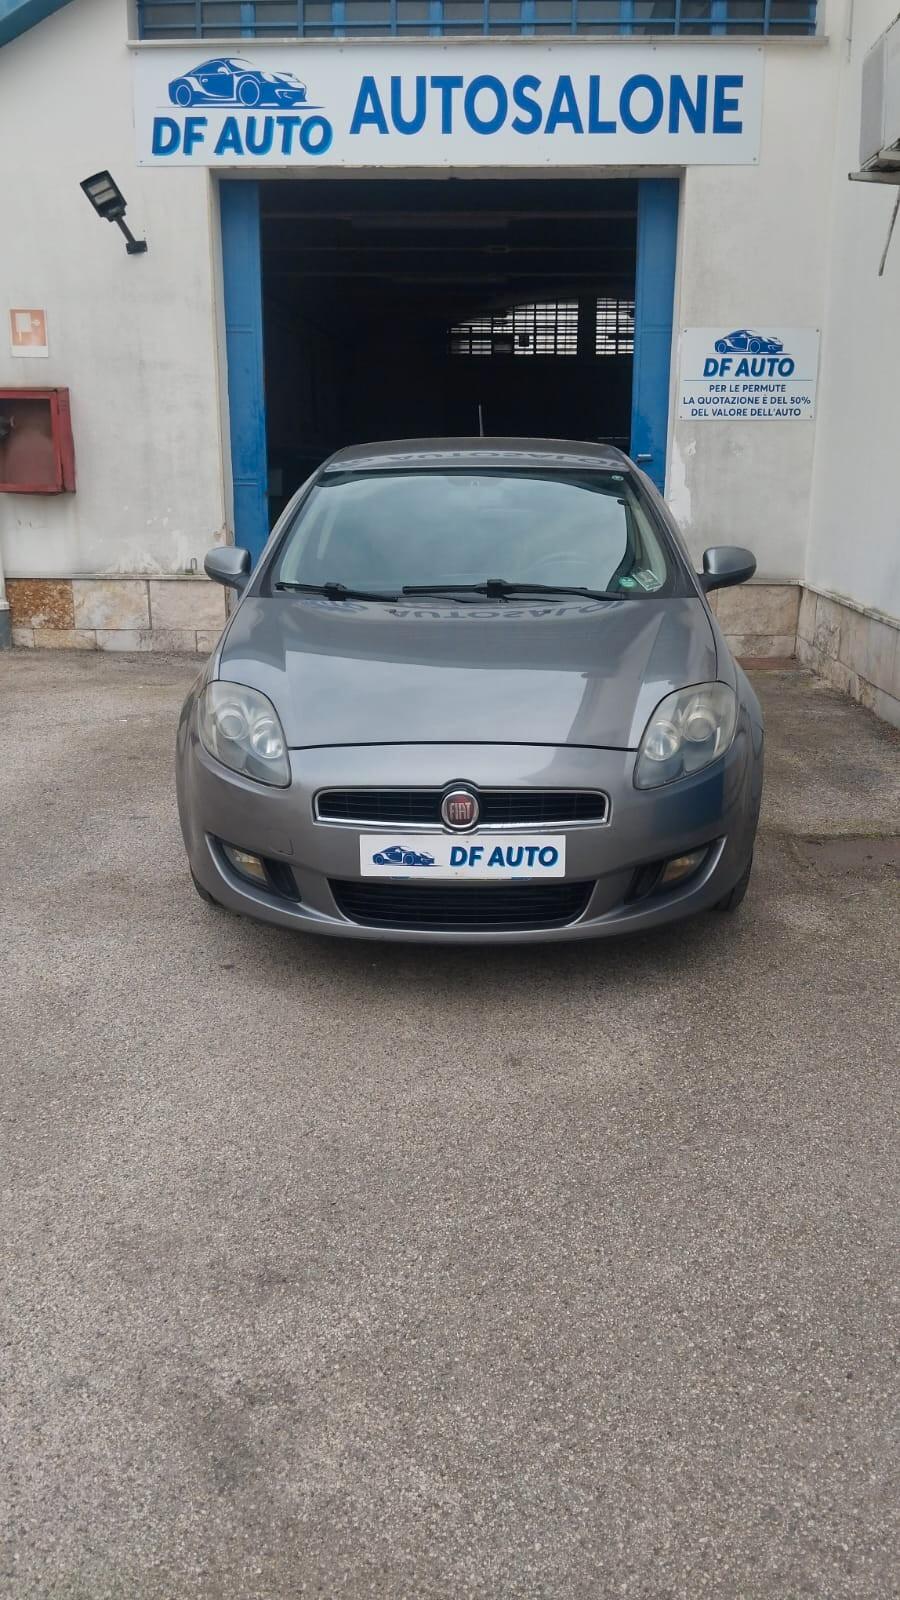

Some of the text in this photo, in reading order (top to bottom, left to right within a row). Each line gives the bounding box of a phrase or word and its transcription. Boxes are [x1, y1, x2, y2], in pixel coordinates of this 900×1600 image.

[350, 73, 743, 135] AUTOSALONE
[151, 115, 333, 156] DF AUTO
[703, 358, 795, 377] DF AUTO
[709, 384, 786, 393] PER LE PERMUTE
[683, 396, 695, 405] LA
[697, 396, 760, 405] QUOTAZIONE
[770, 396, 788, 405] DEL
[790, 396, 811, 405] 50%
[691, 408, 801, 417] DEL VALORE DELL'AUTO
[448, 802, 472, 820] FIAT
[450, 846, 559, 867] DF AUTO
